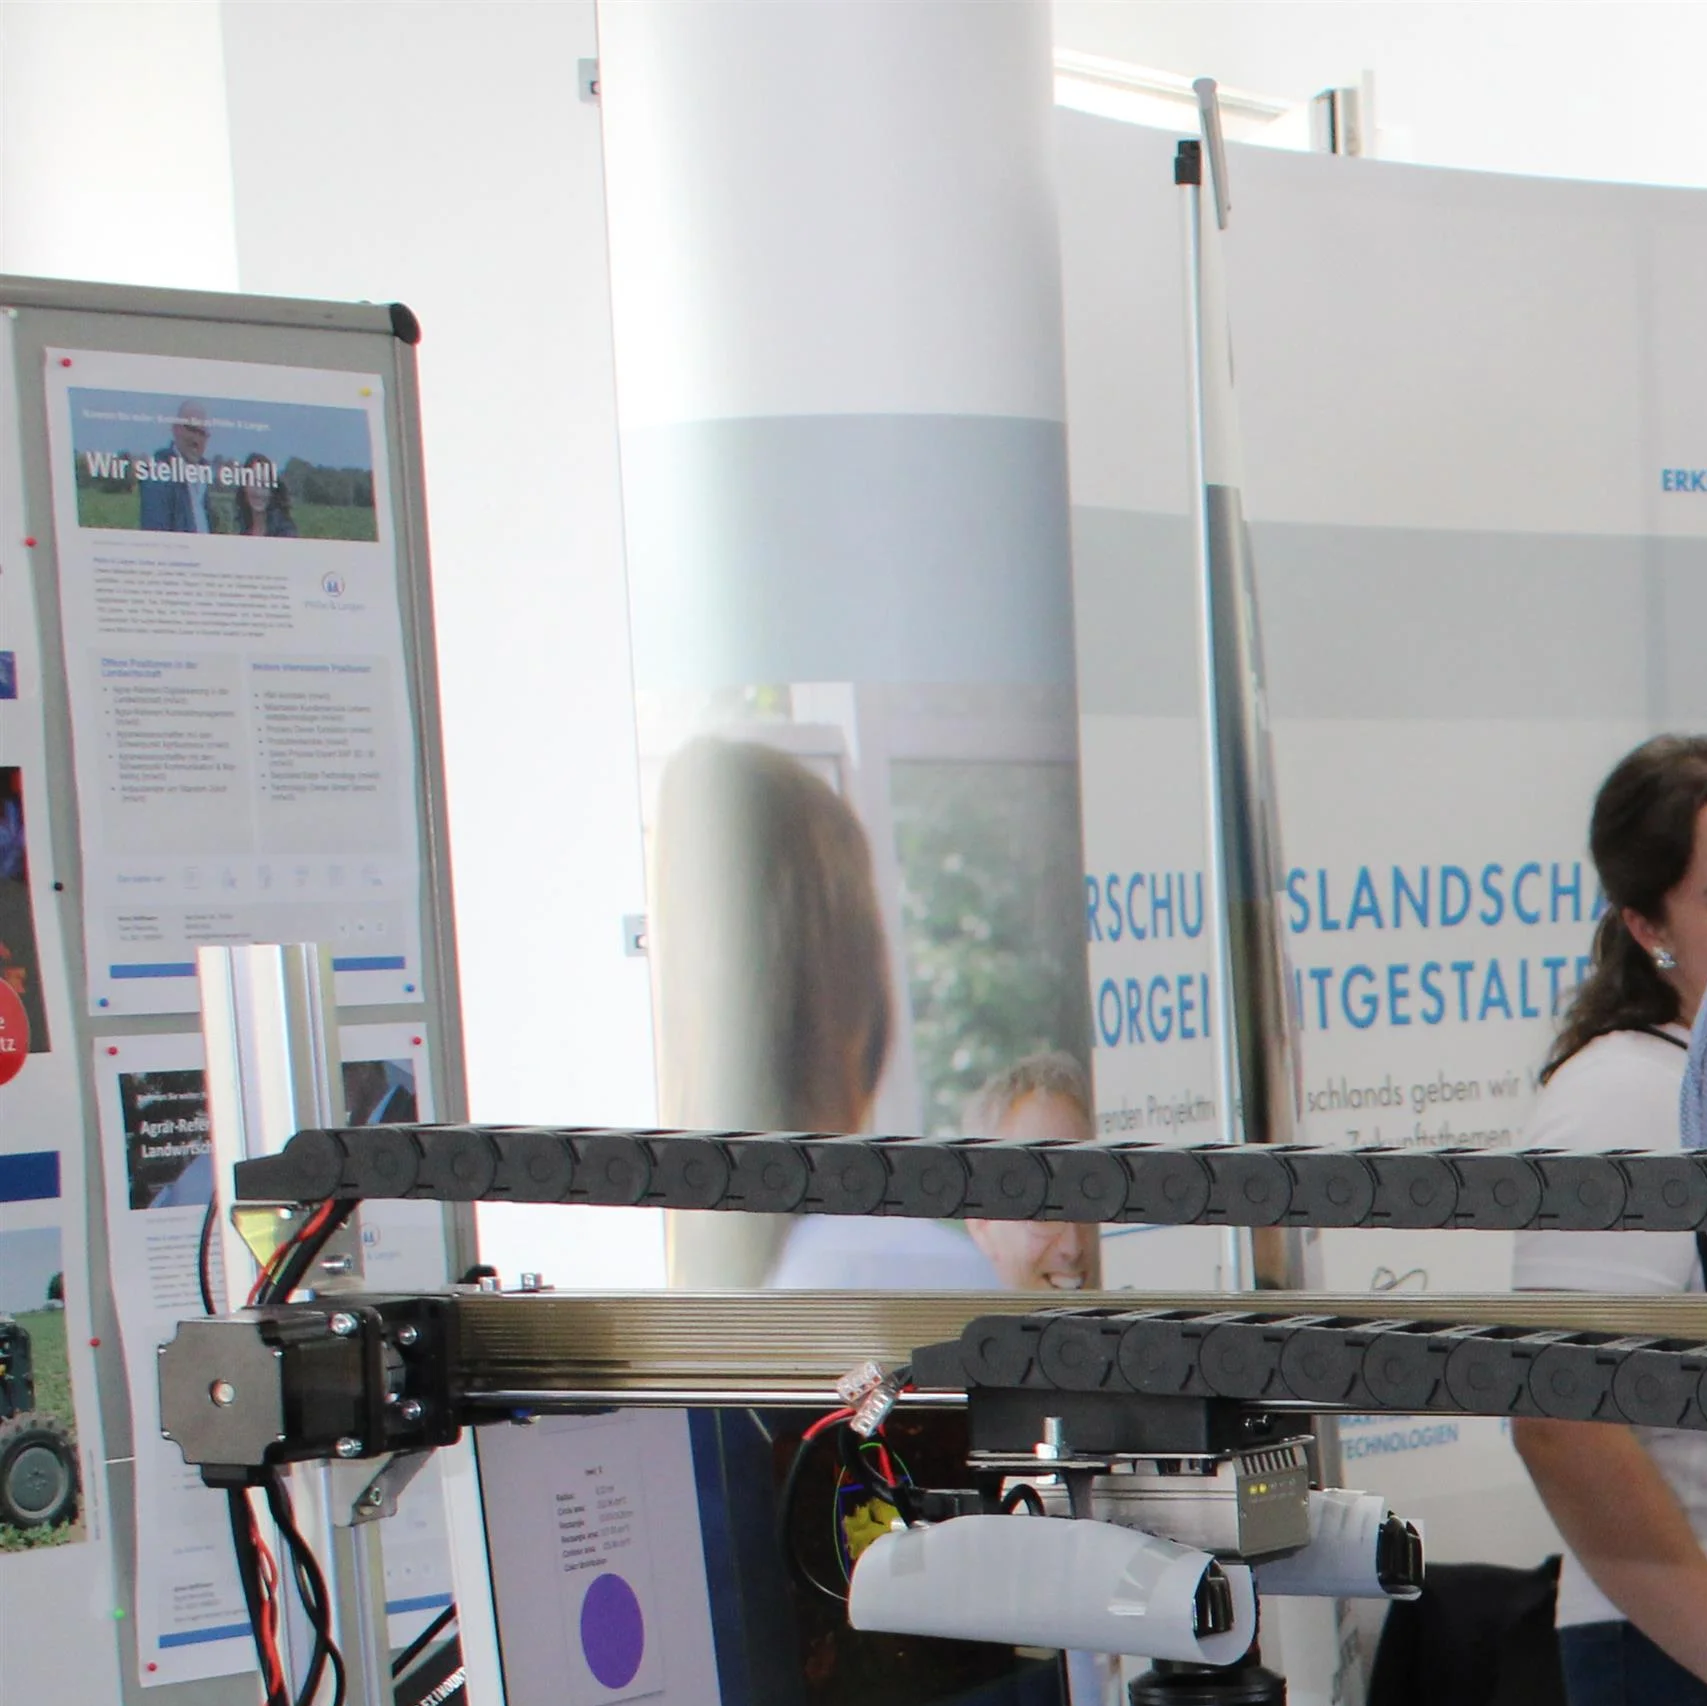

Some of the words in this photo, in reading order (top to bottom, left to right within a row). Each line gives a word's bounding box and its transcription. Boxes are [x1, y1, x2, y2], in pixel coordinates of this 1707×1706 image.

[85, 451, 129, 480] Wir
[135, 455, 213, 484] stellen
[1307, 1073, 1404, 1113] schlands
[1410, 1069, 1480, 1115] geben
[1489, 1070, 1521, 1098] wir
